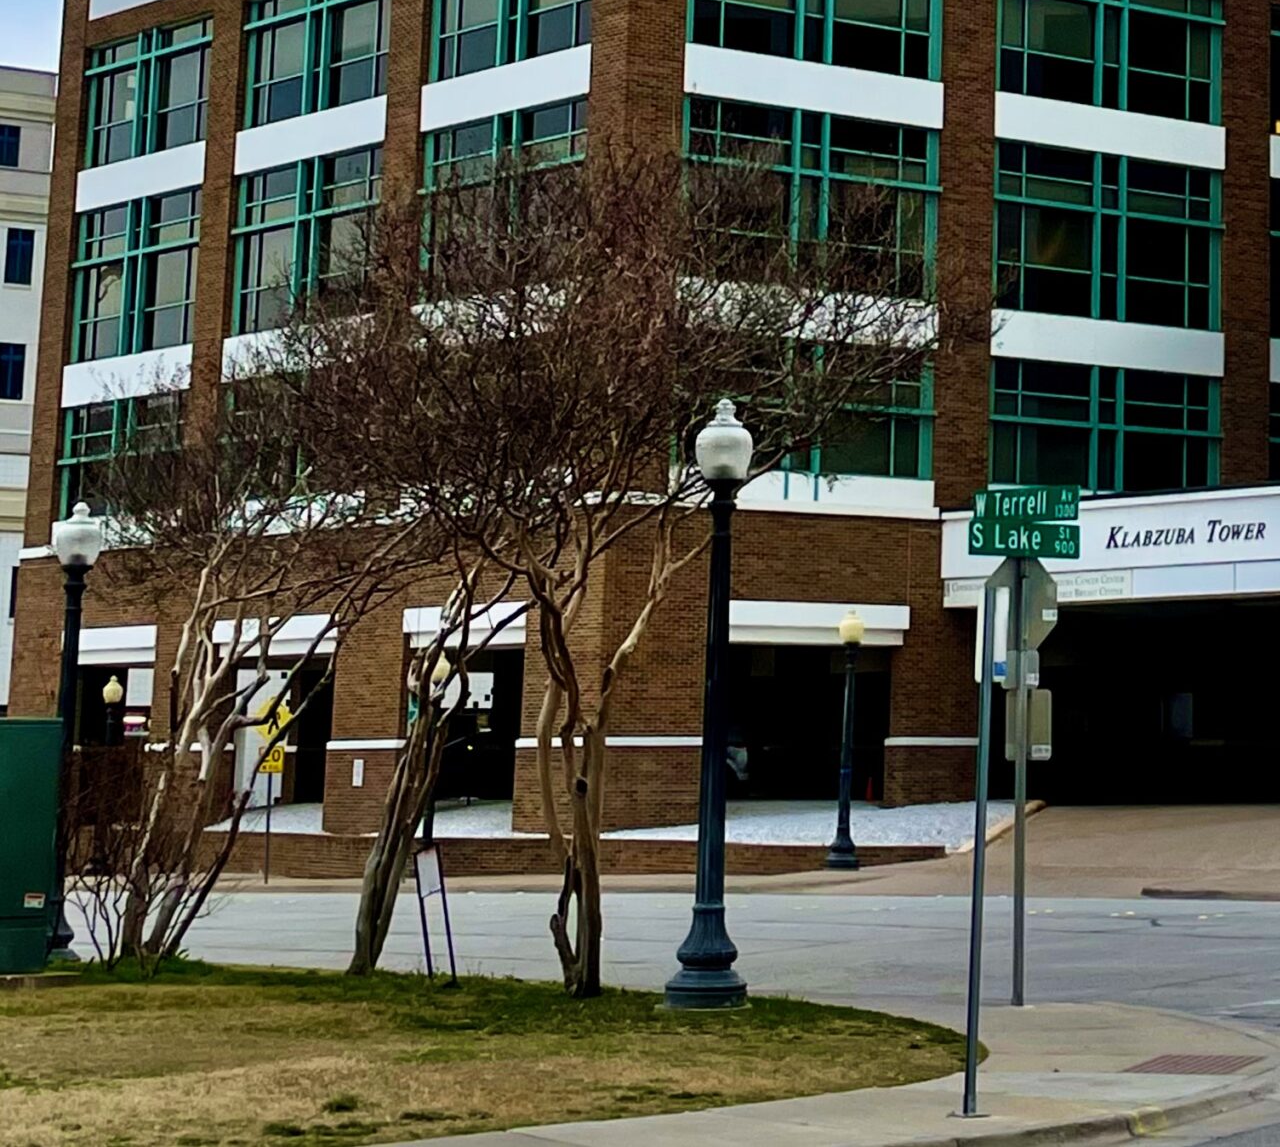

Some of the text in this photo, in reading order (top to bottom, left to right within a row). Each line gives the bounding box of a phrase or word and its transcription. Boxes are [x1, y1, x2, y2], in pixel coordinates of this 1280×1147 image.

[975, 490, 1047, 518] W Terrell
[1061, 489, 1073, 502] Av
[972, 523, 1042, 550] S Lake
[1054, 540, 1075, 554] 900
[1106, 519, 1267, 550] KLABZUBA TOWER
